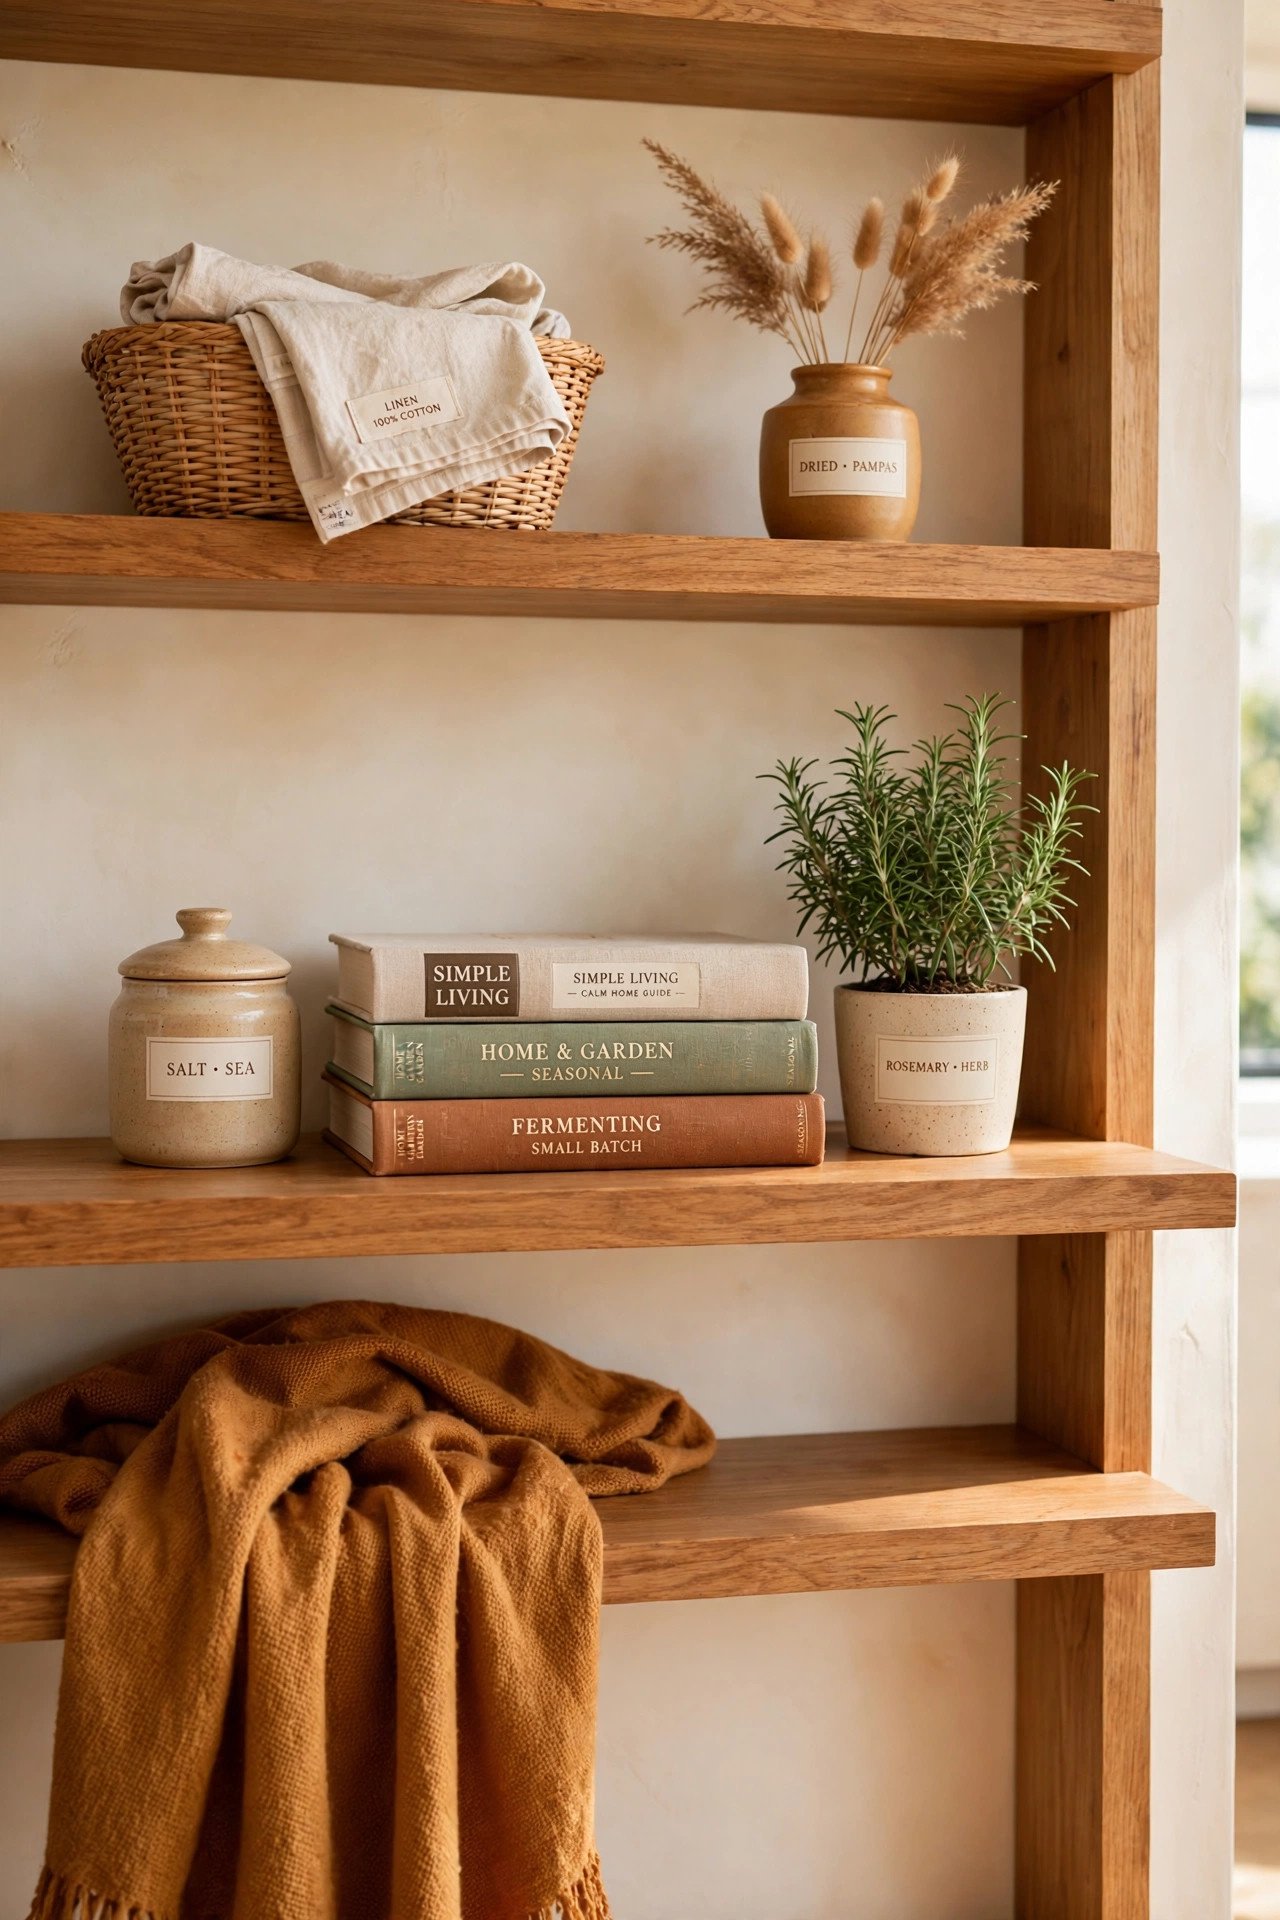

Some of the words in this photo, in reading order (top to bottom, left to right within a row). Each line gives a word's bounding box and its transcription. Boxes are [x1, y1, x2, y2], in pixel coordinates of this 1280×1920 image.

[384, 395, 418, 412] LINEN
[373, 414, 399, 427] 100%
[400, 403, 441, 421] COTTON
[800, 460, 838, 473] DRIED
[853, 460, 898, 473] PAMPAS
[433, 965, 511, 982] SIMPLE
[573, 972, 625, 985] SIMPLE
[630, 972, 679, 985] LIVING
[435, 988, 509, 1006] LIVING
[580, 989, 607, 998] CALM
[611, 988, 639, 998] HOME
[642, 988, 672, 998] GUIDE
[481, 1043, 549, 1061] HOME
[557, 1043, 573, 1060] &
[580, 1042, 674, 1060] GARDEN
[167, 1062, 207, 1076] SALT
[225, 1061, 256, 1076] SEA
[532, 1066, 624, 1081] SEASONAL
[886, 1060, 950, 1073] ROSEMARY
[961, 1060, 989, 1072] HERB
[512, 1115, 662, 1136] FERMENTING
[531, 1141, 584, 1155] SMALL
[590, 1140, 642, 1153] BATCH
